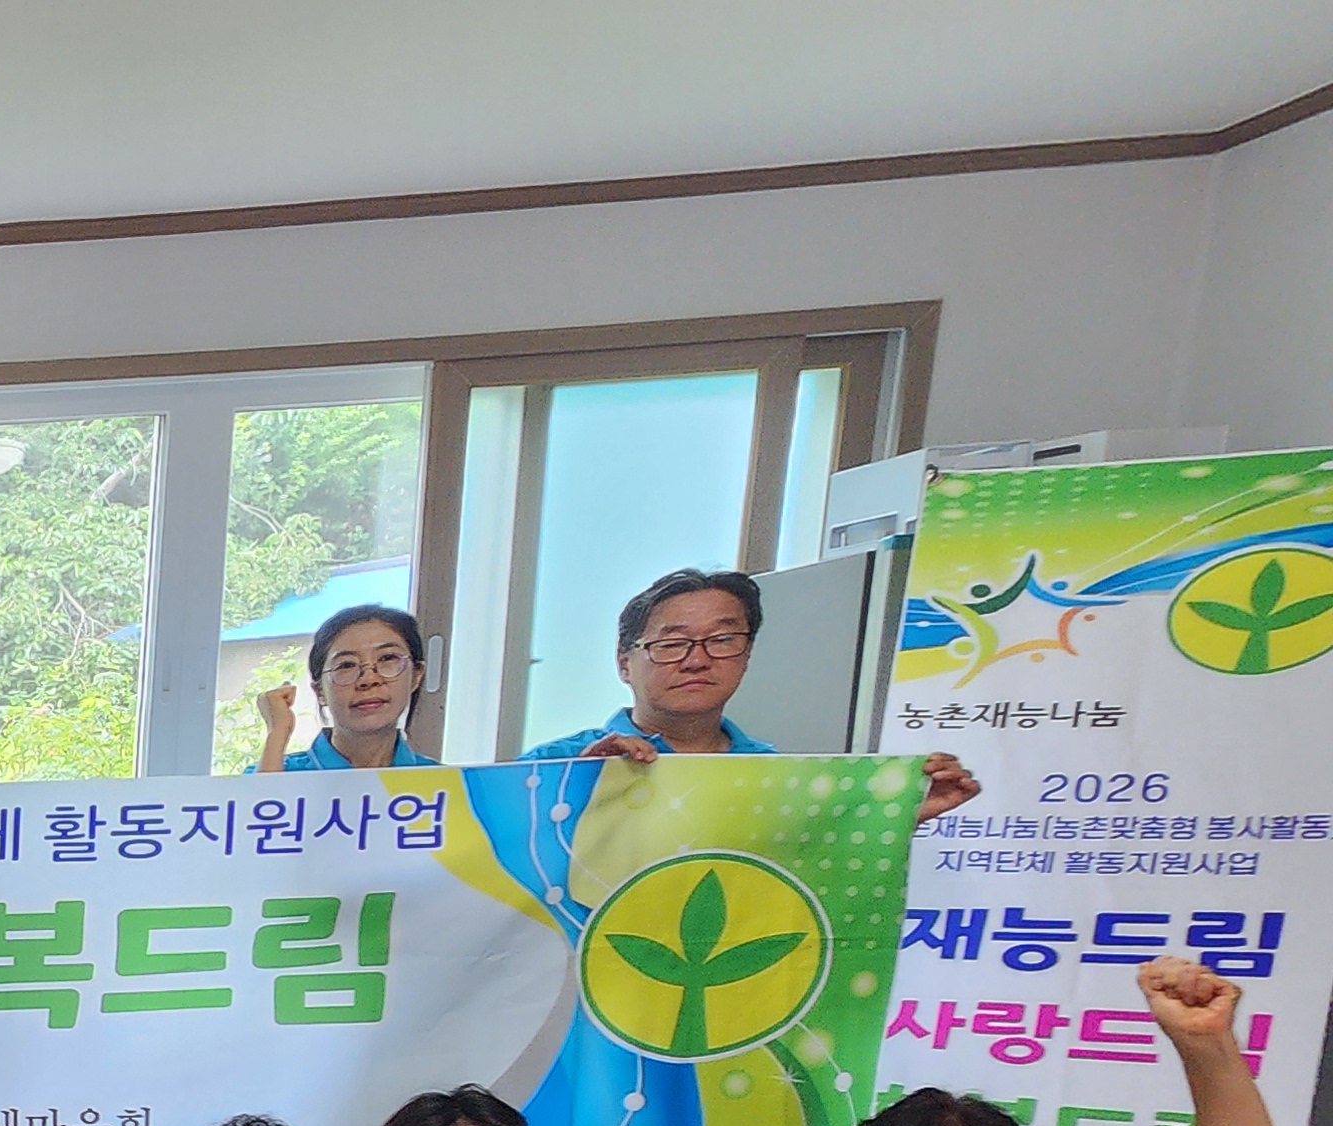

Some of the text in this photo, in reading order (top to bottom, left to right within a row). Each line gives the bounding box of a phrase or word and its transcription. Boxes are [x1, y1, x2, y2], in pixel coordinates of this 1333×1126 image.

[896, 700, 1128, 730] 농촌재능나눔
[1038, 771, 1172, 804] 2026
[42, 790, 448, 864] 활동지원사업
[1207, 815, 1333, 841] 봉사활동
[935, 850, 1261, 877] 지역단체 활동지원사업
[900, 906, 1287, 978] 재능드림
